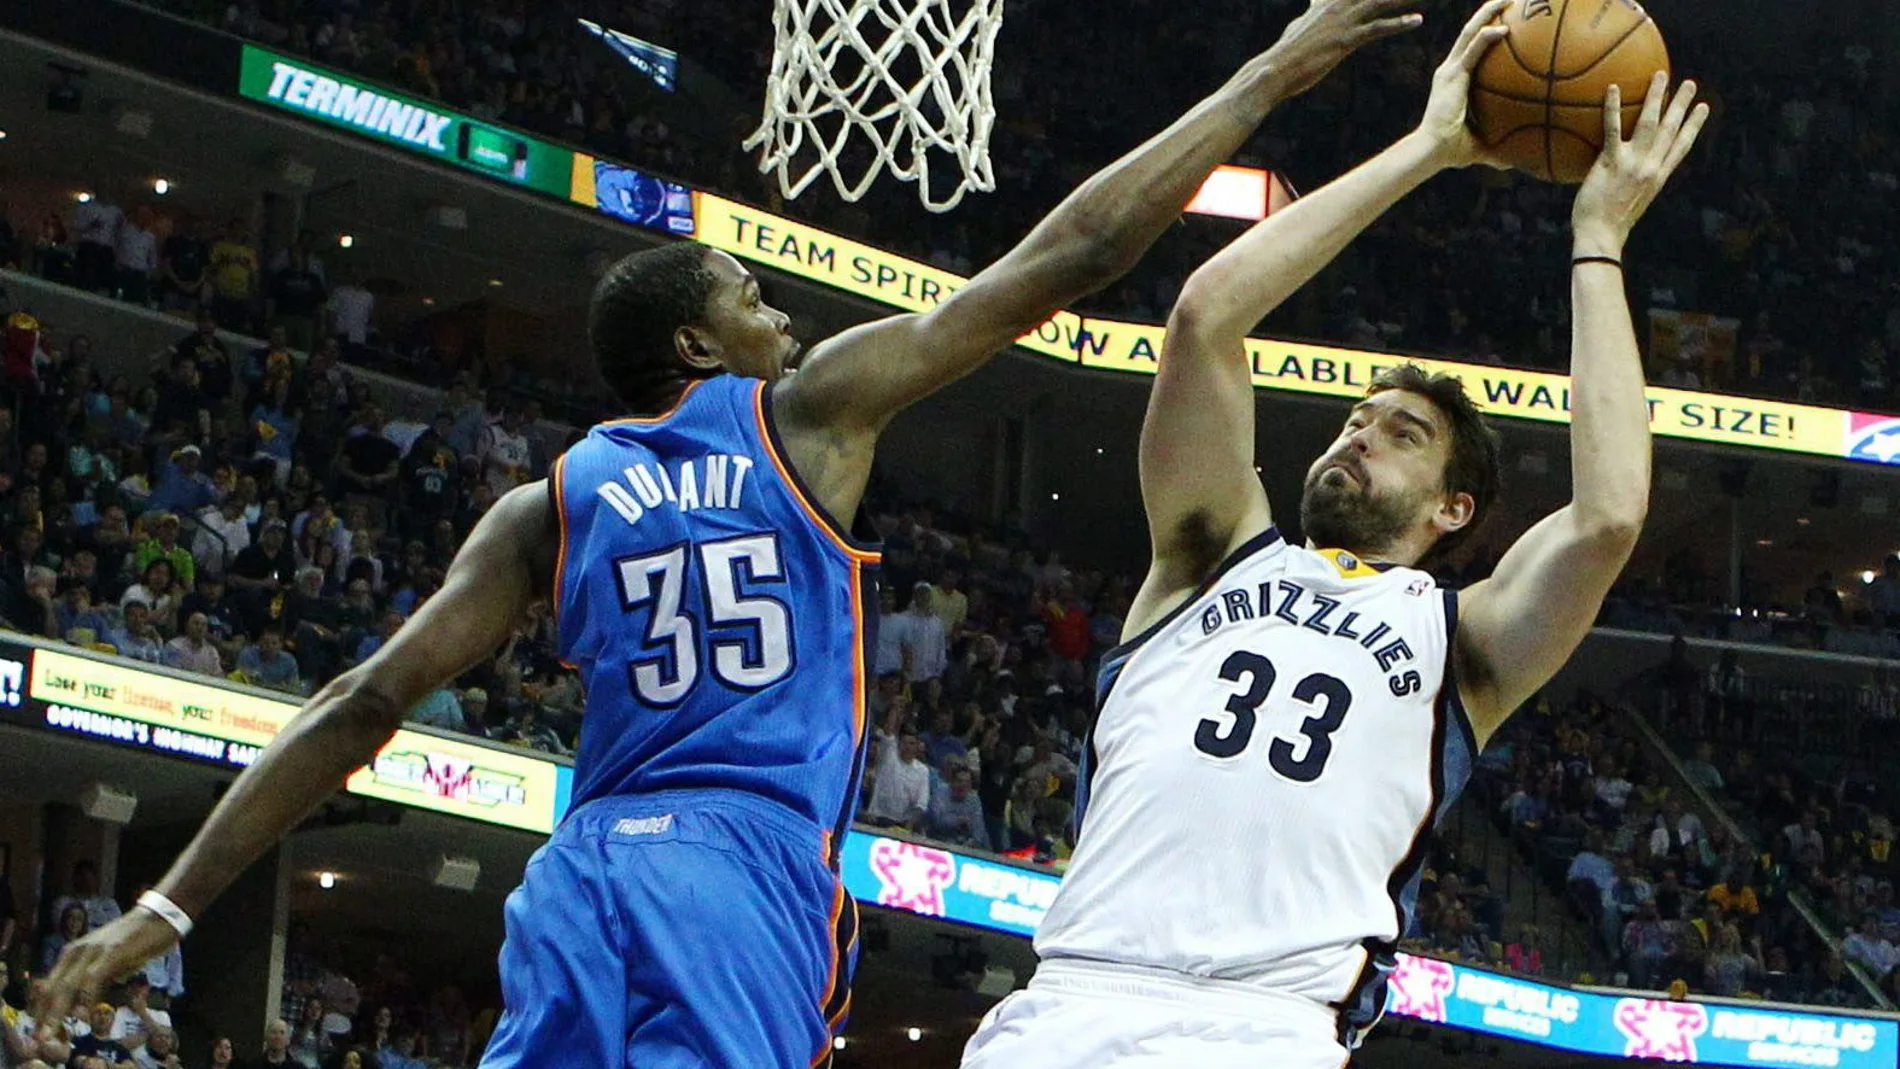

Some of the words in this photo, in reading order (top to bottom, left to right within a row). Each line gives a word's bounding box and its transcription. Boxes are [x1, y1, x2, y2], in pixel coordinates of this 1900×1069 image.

[267, 62, 450, 151] TERMINIX
[729, 215, 834, 273] TEAM
[1037, 320, 1109, 356] OW
[1680, 403, 1795, 439] SIZE!
[614, 531, 796, 709] 35
[1201, 580, 1421, 697] GRIZZLIES
[1194, 650, 1352, 782] 33
[1456, 973, 1580, 1023] REPUBLIC
[1712, 1011, 1877, 1051] REPUBLIC
